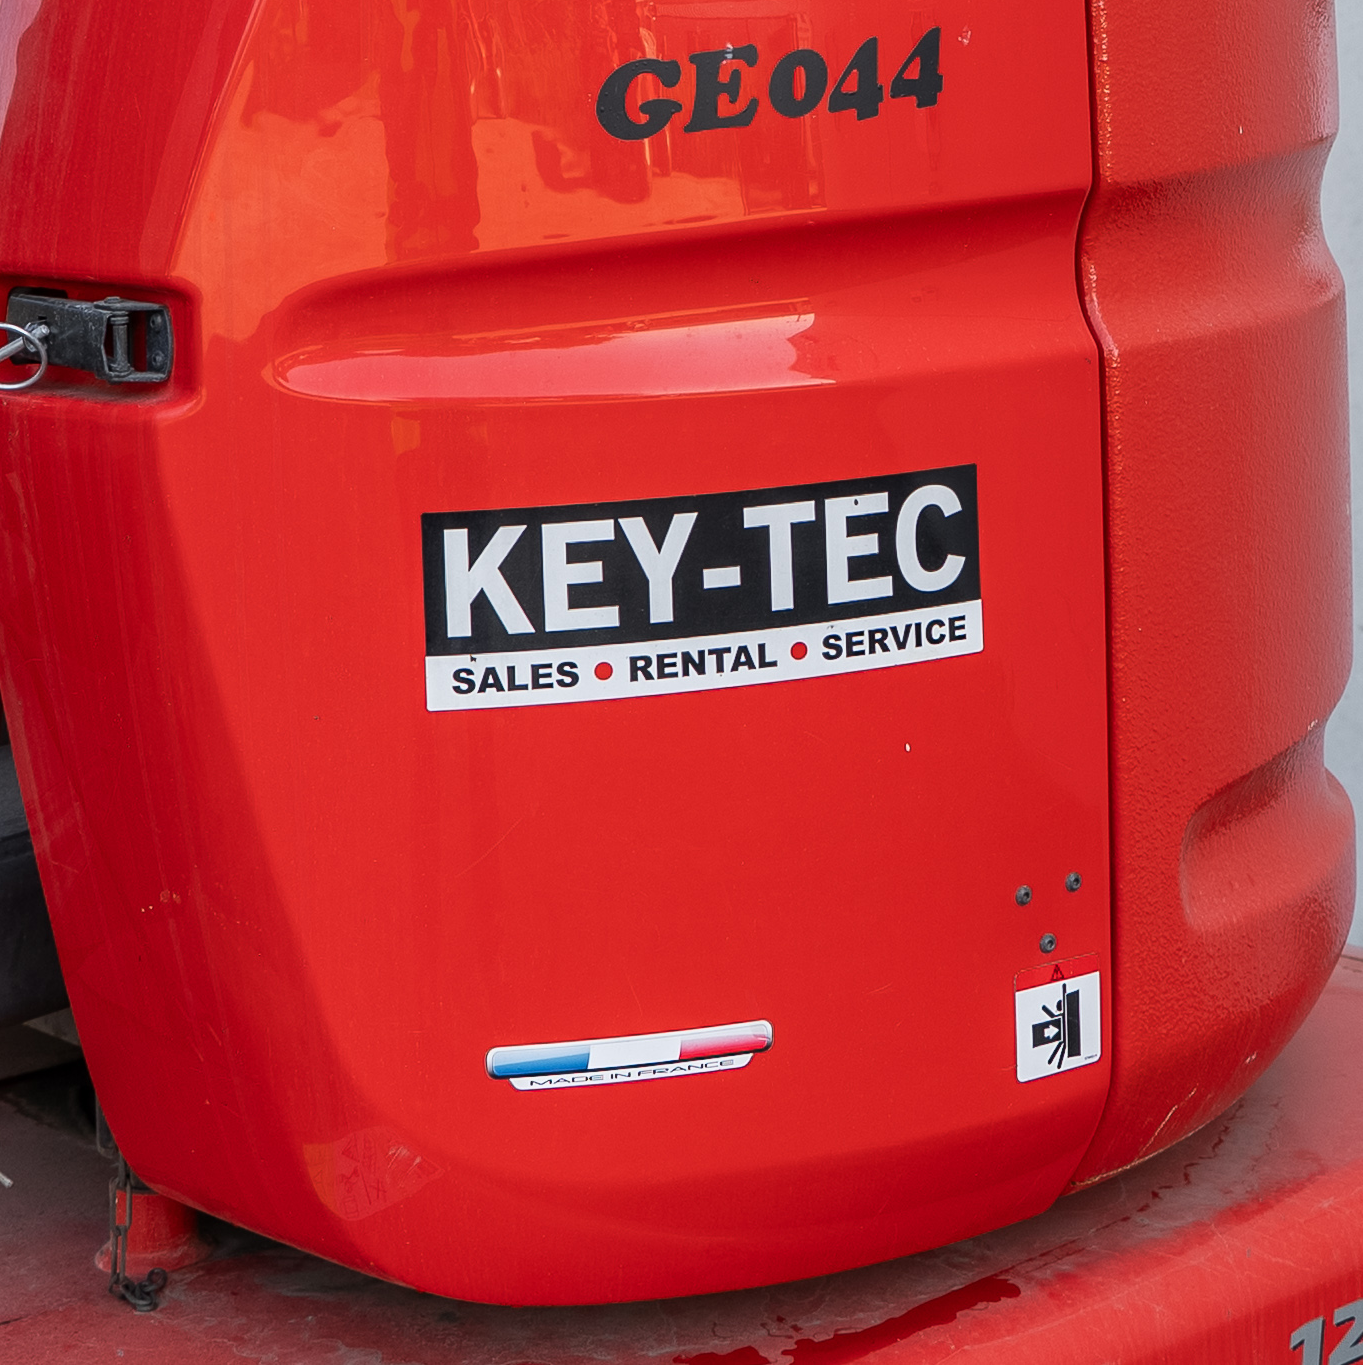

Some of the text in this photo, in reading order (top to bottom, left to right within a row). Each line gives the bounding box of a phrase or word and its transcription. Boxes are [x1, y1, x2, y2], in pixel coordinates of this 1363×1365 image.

[596, 27, 944, 141] GE044
[443, 485, 966, 638] KEY-TEC
[451, 615, 967, 695] SALES RENTAL SERVICE
[530, 1059, 734, 1086] MADE IN FRANCE
